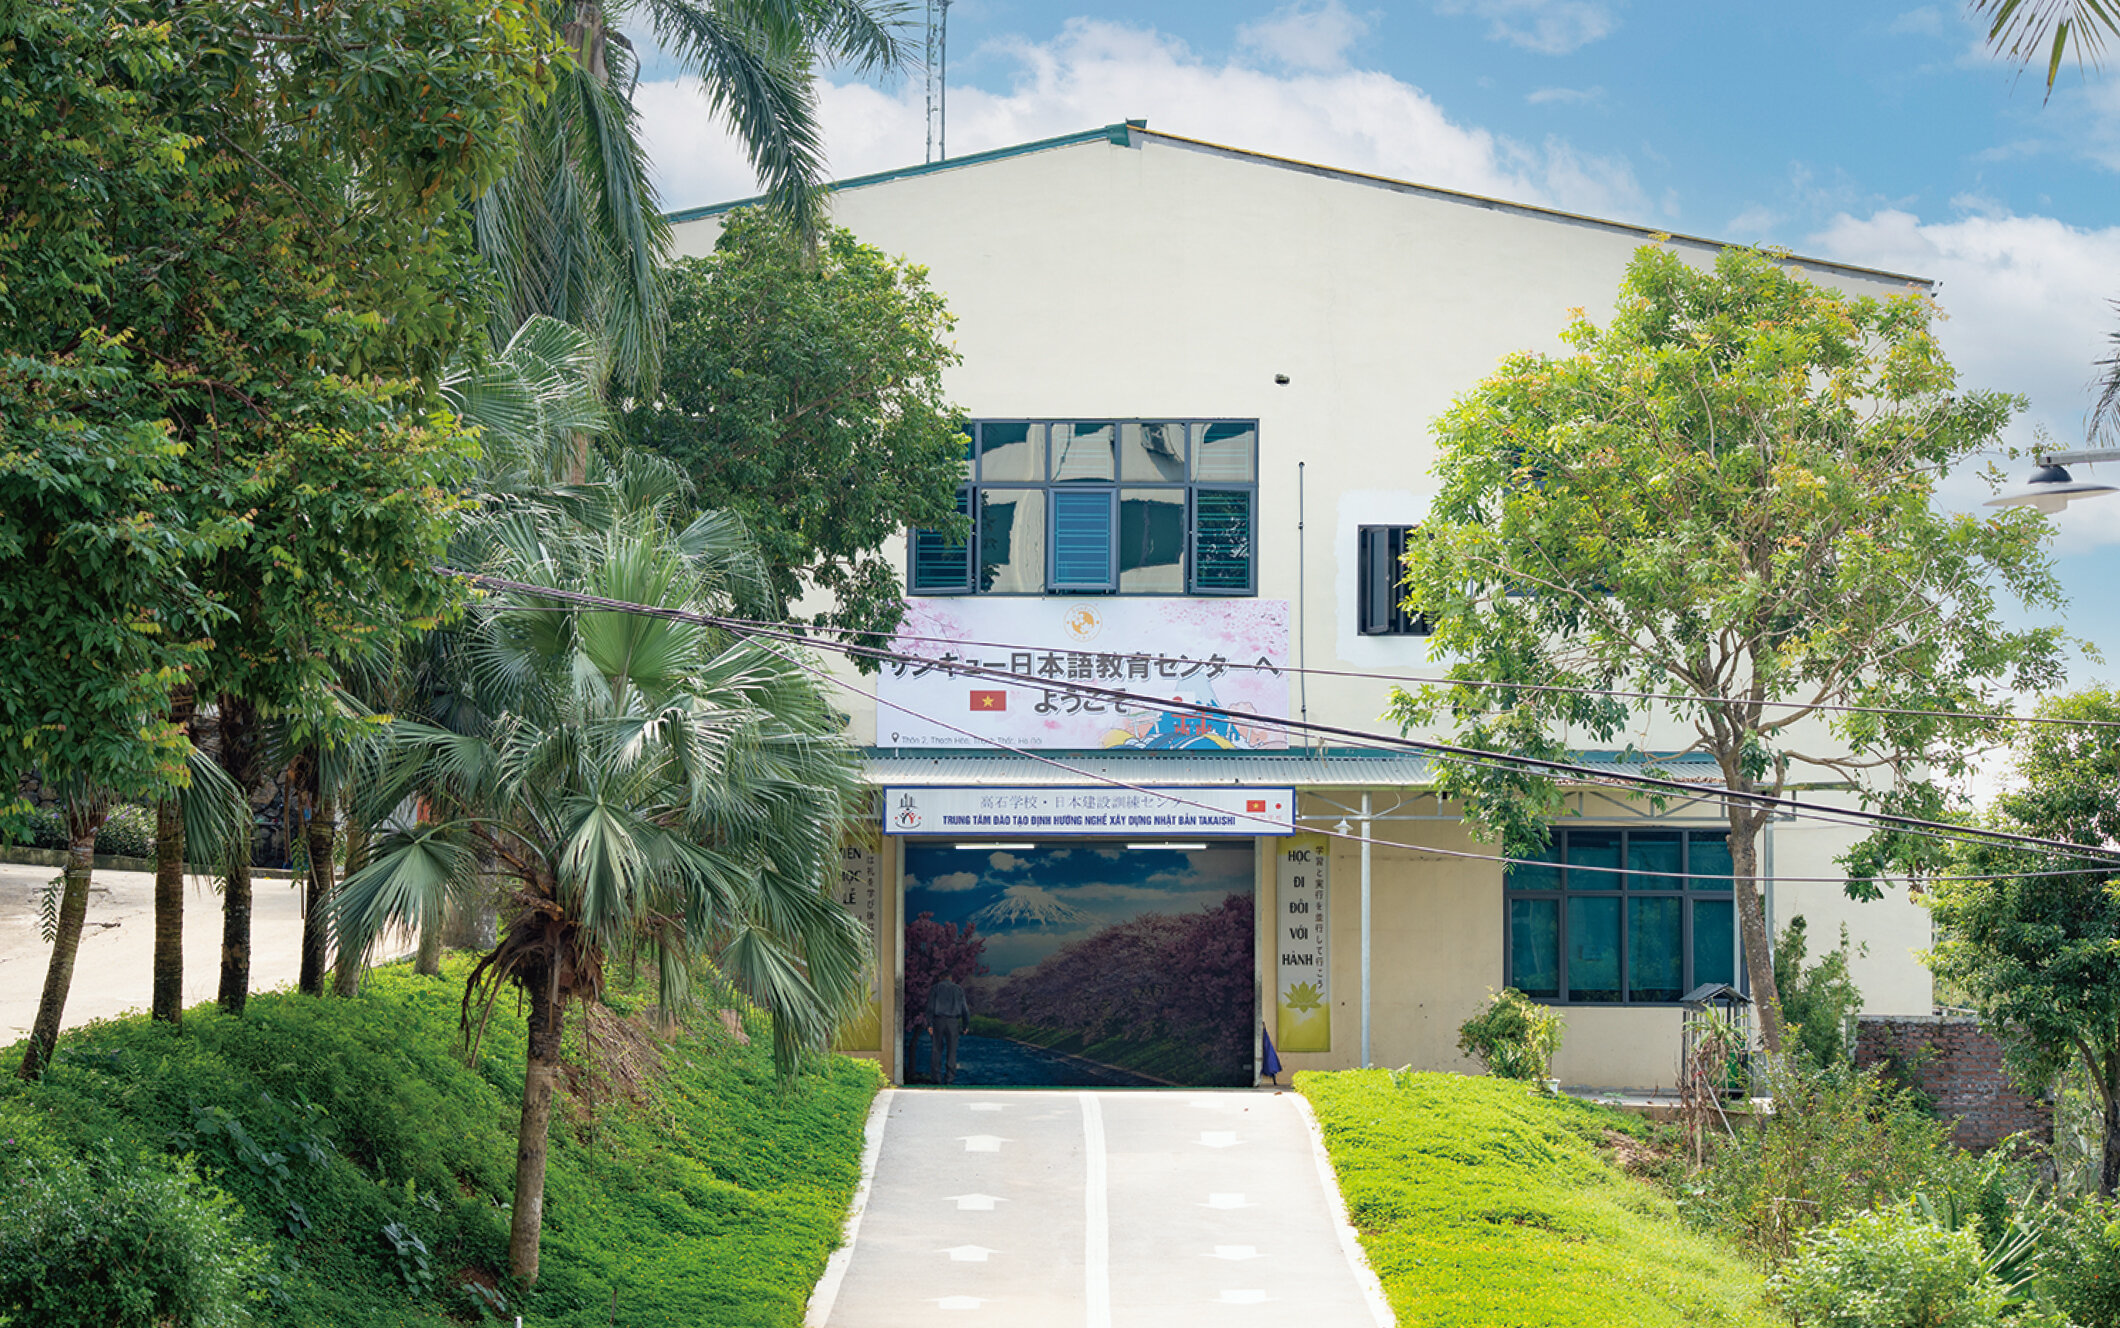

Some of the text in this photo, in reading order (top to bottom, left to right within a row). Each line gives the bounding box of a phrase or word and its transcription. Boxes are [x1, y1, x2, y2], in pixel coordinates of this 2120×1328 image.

[1033, 687, 1128, 715] ようこそ
[943, 815, 971, 825] TRUNG
[973, 814, 991, 825] TÂM
[993, 814, 1011, 825] ĐÀO
[1013, 815, 1029, 827] TẠO
[1031, 815, 1051, 827] ĐỊNH
[1110, 813, 1126, 825] XÂY
[1154, 813, 1177, 827] NHẬT
[1178, 812, 1196, 825] BẢN
[1199, 815, 1236, 826] TAKAISHI
[1288, 850, 1311, 865] HỌC
[1293, 876, 1305, 888] ĐI
[1289, 898, 1309, 914] ĐÔI
[1289, 924, 1309, 940] VỚI
[1282, 951, 1313, 966] HÀNH
